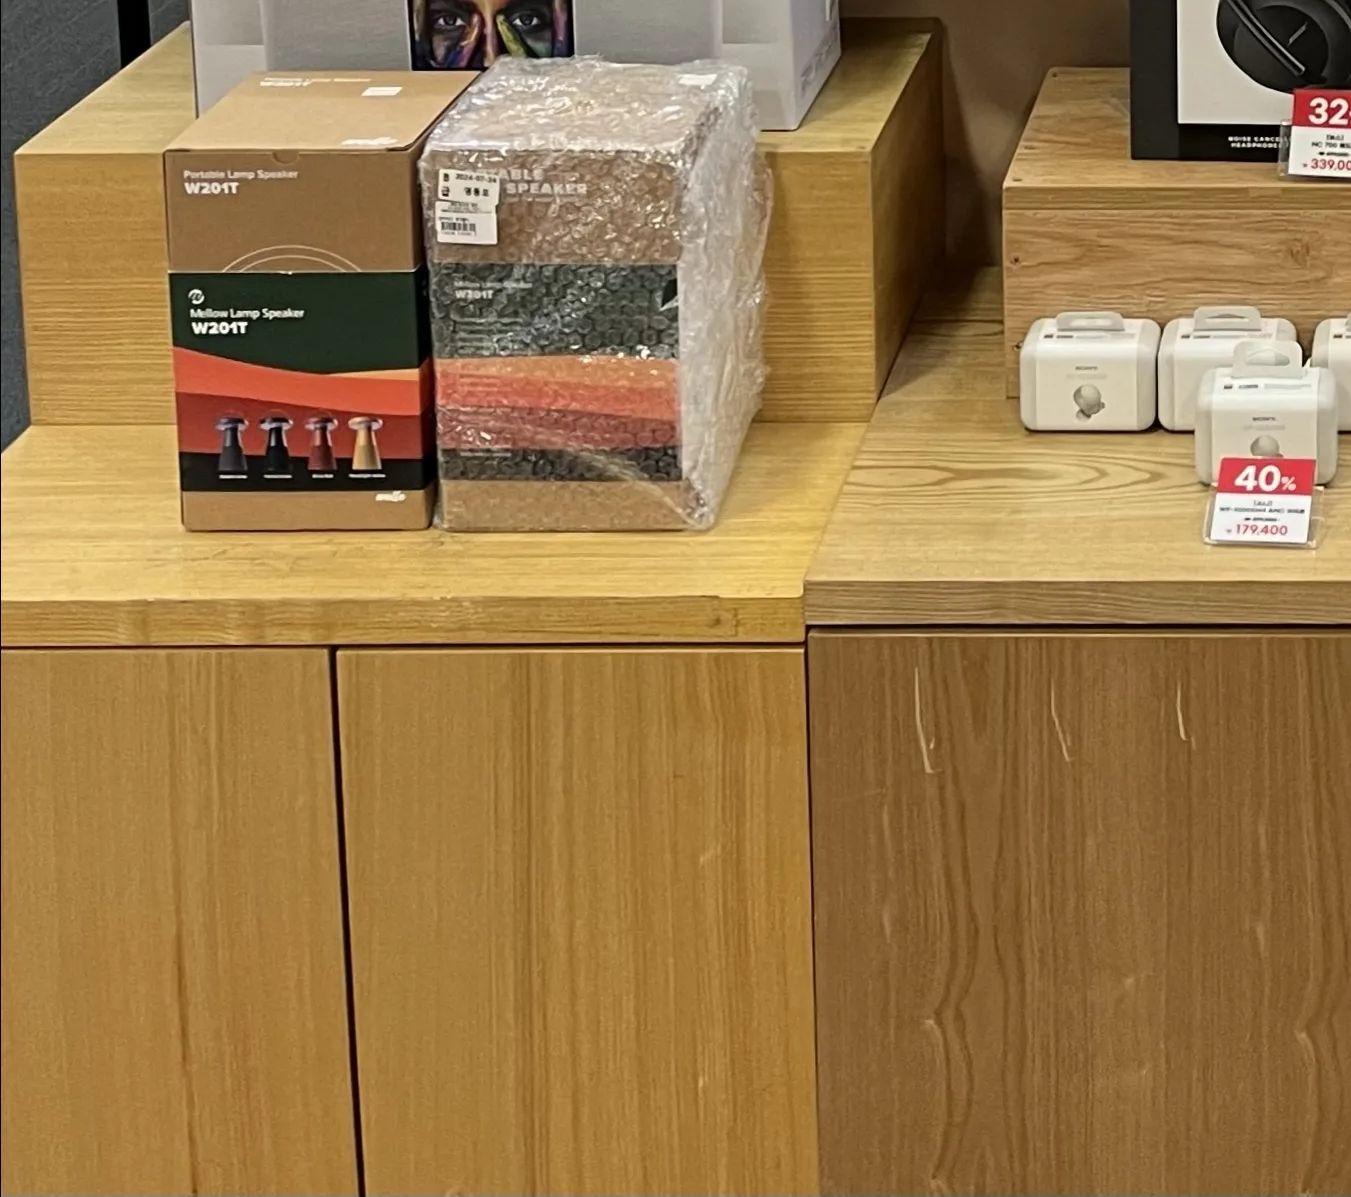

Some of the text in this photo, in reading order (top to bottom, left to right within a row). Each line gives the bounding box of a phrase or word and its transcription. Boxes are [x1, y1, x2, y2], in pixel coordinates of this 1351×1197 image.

[183, 169, 298, 180] Portable Lamp Speaker
[184, 181, 239, 195] W201T
[506, 182, 588, 195] SPEAKER
[189, 308, 304, 320] Mellow Lamp Speaker
[191, 321, 248, 335] W201T
[1234, 464, 1297, 492] 40%
